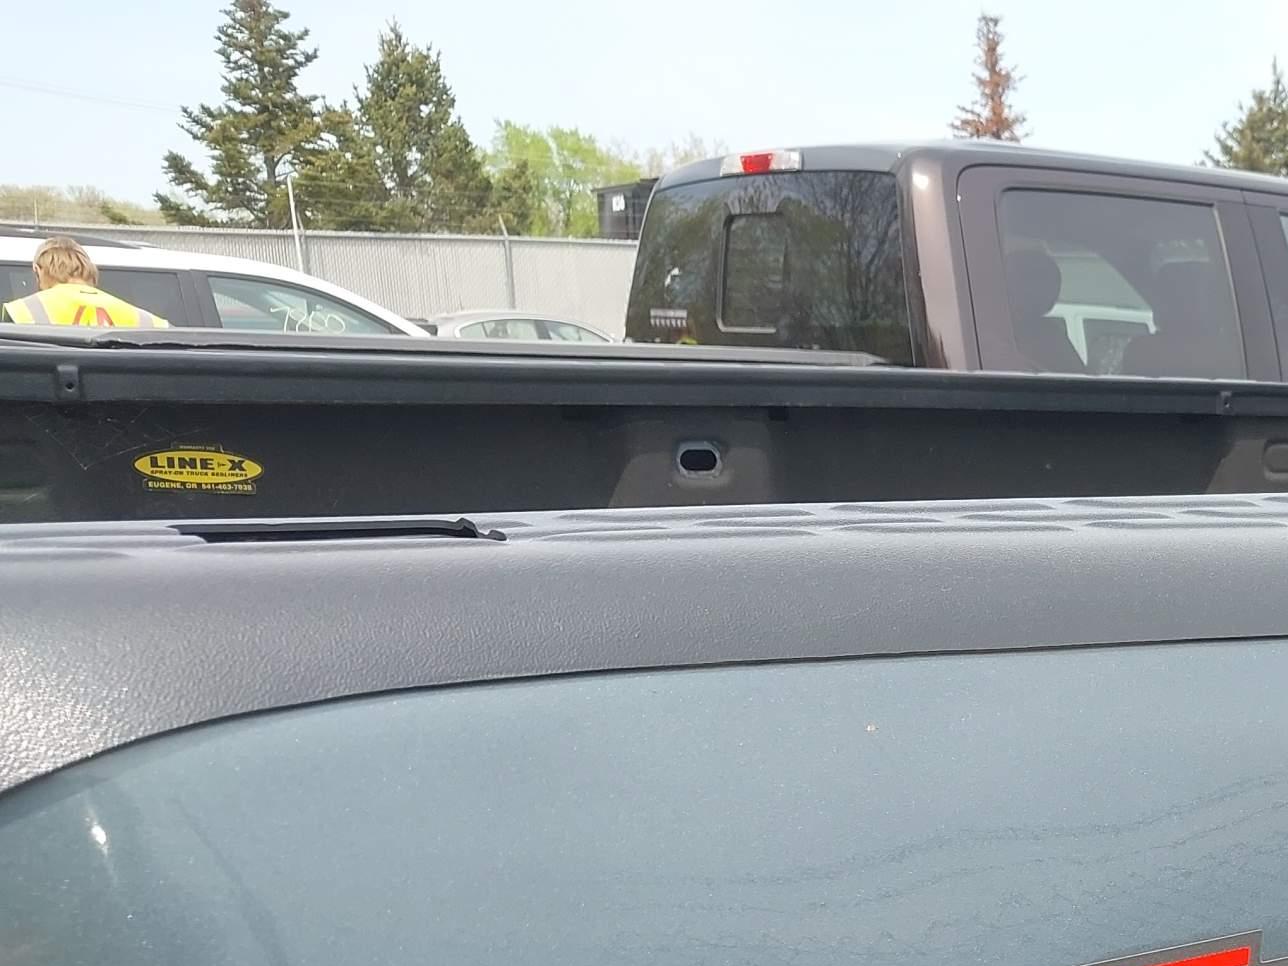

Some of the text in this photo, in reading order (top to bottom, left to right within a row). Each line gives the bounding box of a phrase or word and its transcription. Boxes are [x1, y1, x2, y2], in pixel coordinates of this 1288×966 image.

[149, 456, 248, 472] LINE-X
[148, 481, 184, 490] EUGENE,
[185, 482, 198, 490] OR
